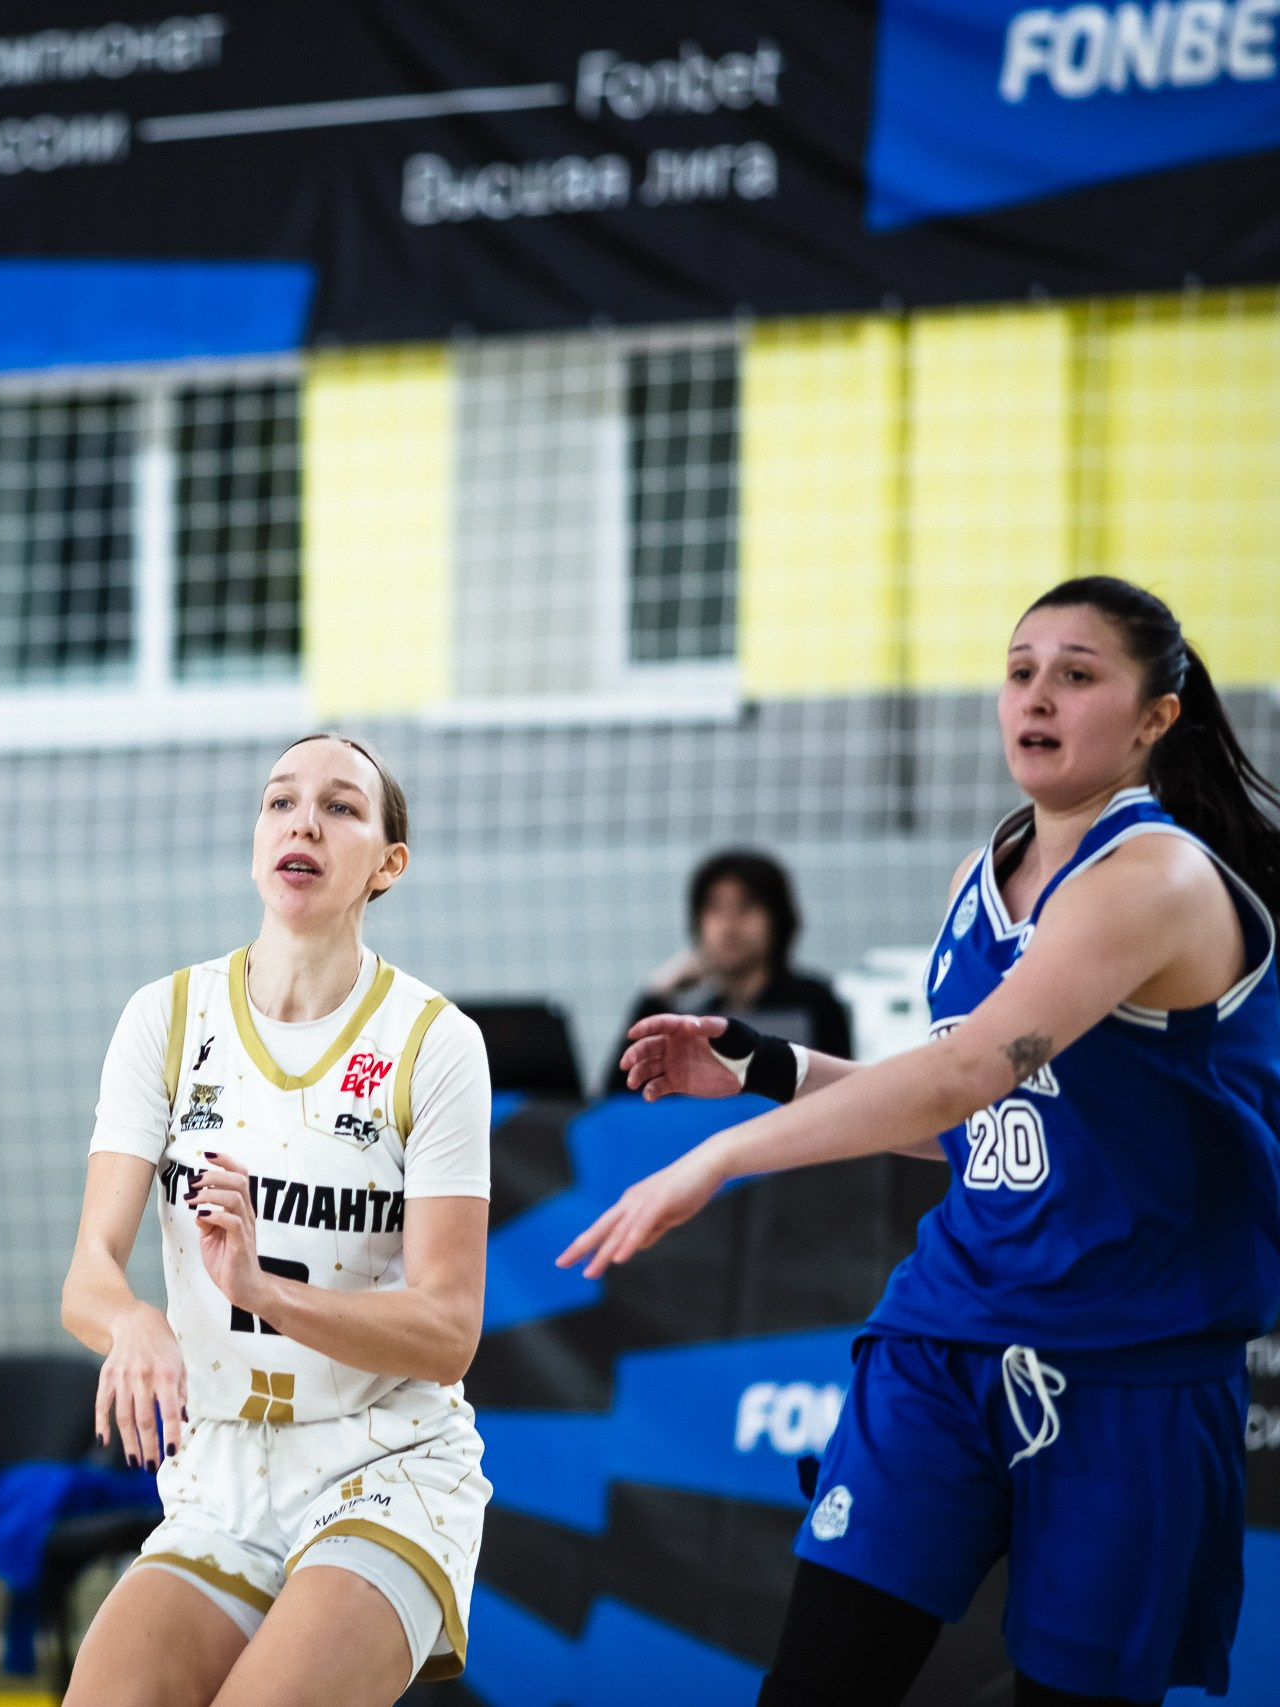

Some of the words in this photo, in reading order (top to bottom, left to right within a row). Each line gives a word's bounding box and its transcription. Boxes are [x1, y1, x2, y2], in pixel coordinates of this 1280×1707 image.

[574, 38, 783, 121] Fonbet
[401, 152, 631, 226] Высшая
[347, 1053, 393, 1080] FON
[963, 1099, 1050, 1191] 20
